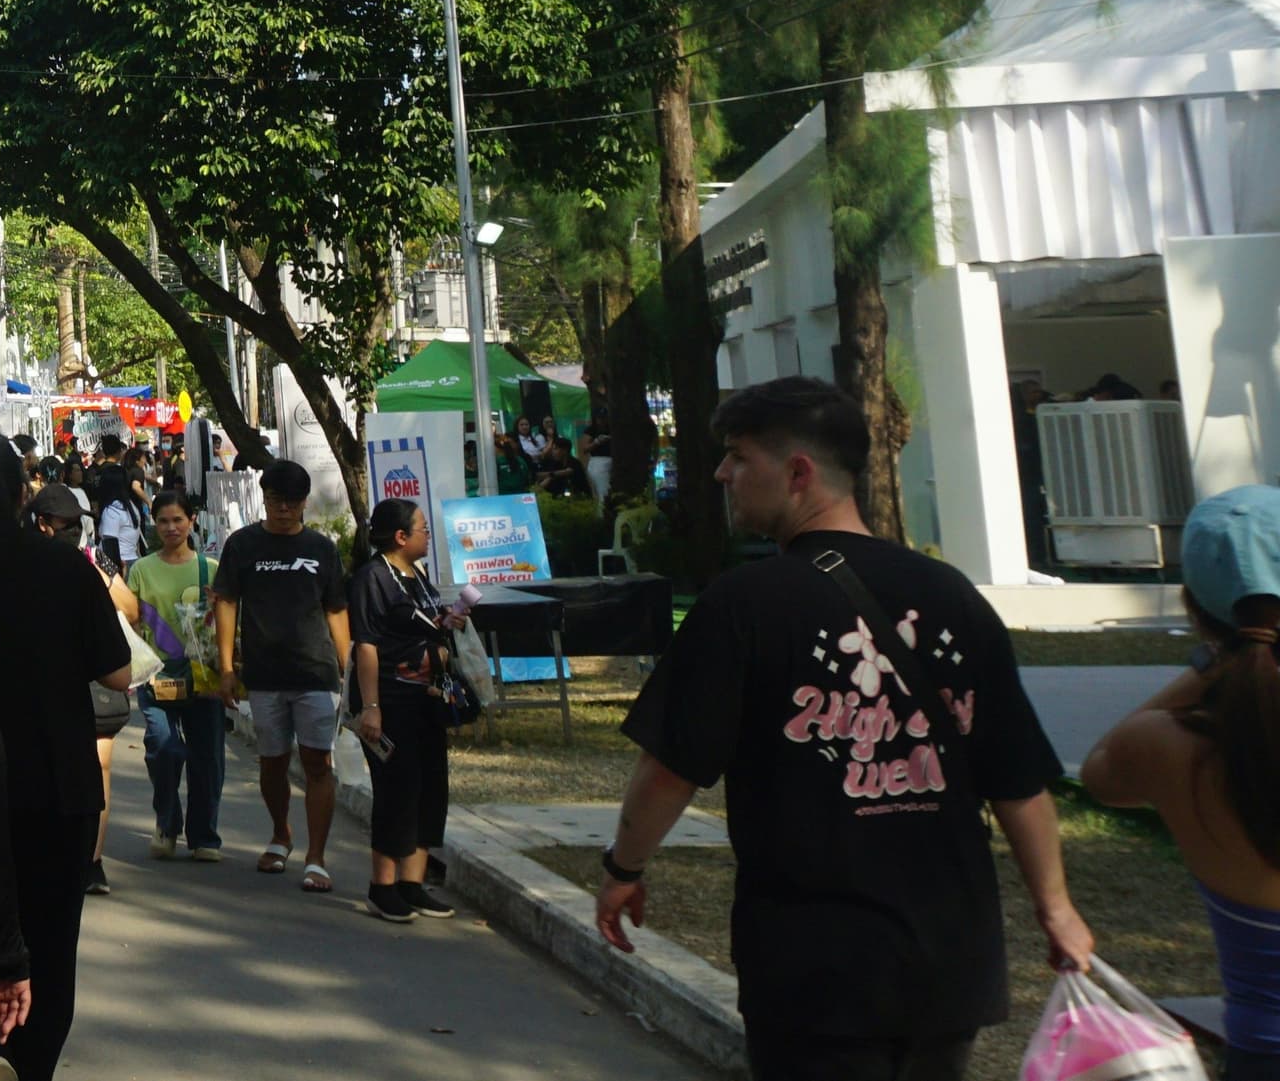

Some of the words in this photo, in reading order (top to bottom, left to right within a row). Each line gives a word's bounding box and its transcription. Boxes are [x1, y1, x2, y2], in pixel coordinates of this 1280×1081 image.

[383, 479, 420, 498] HOME
[457, 519, 506, 532] อาหาร
[255, 564, 290, 572] TYPE
[290, 557, 320, 575] R
[783, 685, 902, 762] High
[843, 742, 947, 799] well
